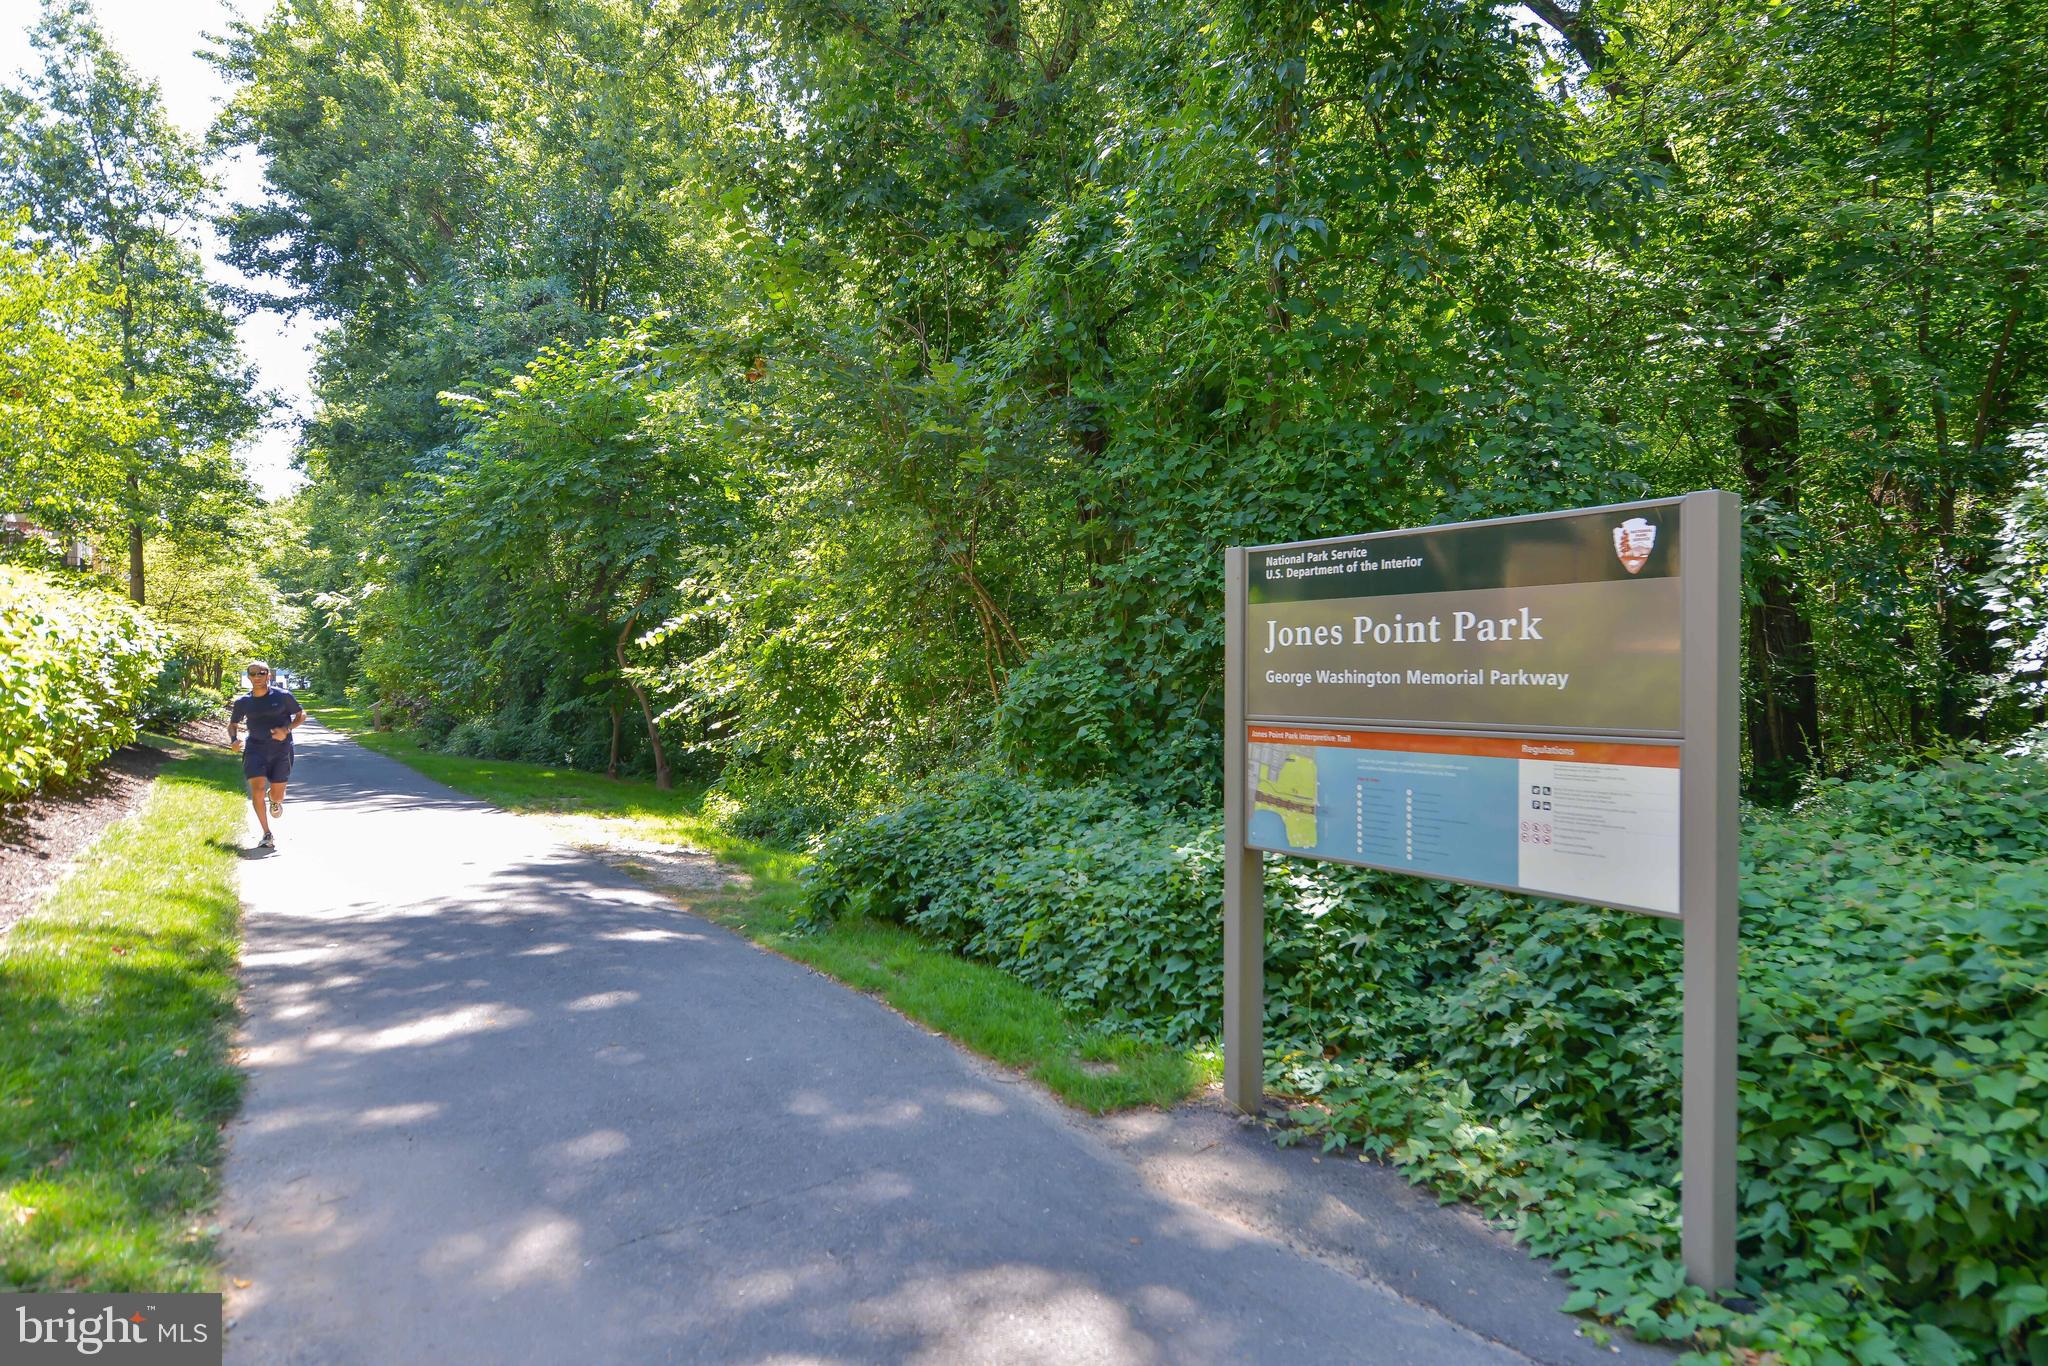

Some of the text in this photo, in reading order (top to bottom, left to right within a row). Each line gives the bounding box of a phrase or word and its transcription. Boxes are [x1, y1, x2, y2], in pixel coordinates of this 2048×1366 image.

[1265, 547, 1367, 567] National Park Service
[1265, 556, 1423, 580] U.S. Department of the Interior
[1264, 606, 1544, 654] Jones Point Park
[1265, 669, 1569, 690] George Washington Memorial Parkway
[1268, 731, 1284, 739] Point
[1285, 731, 1298, 739] Park
[1336, 734, 1352, 742] Trail
